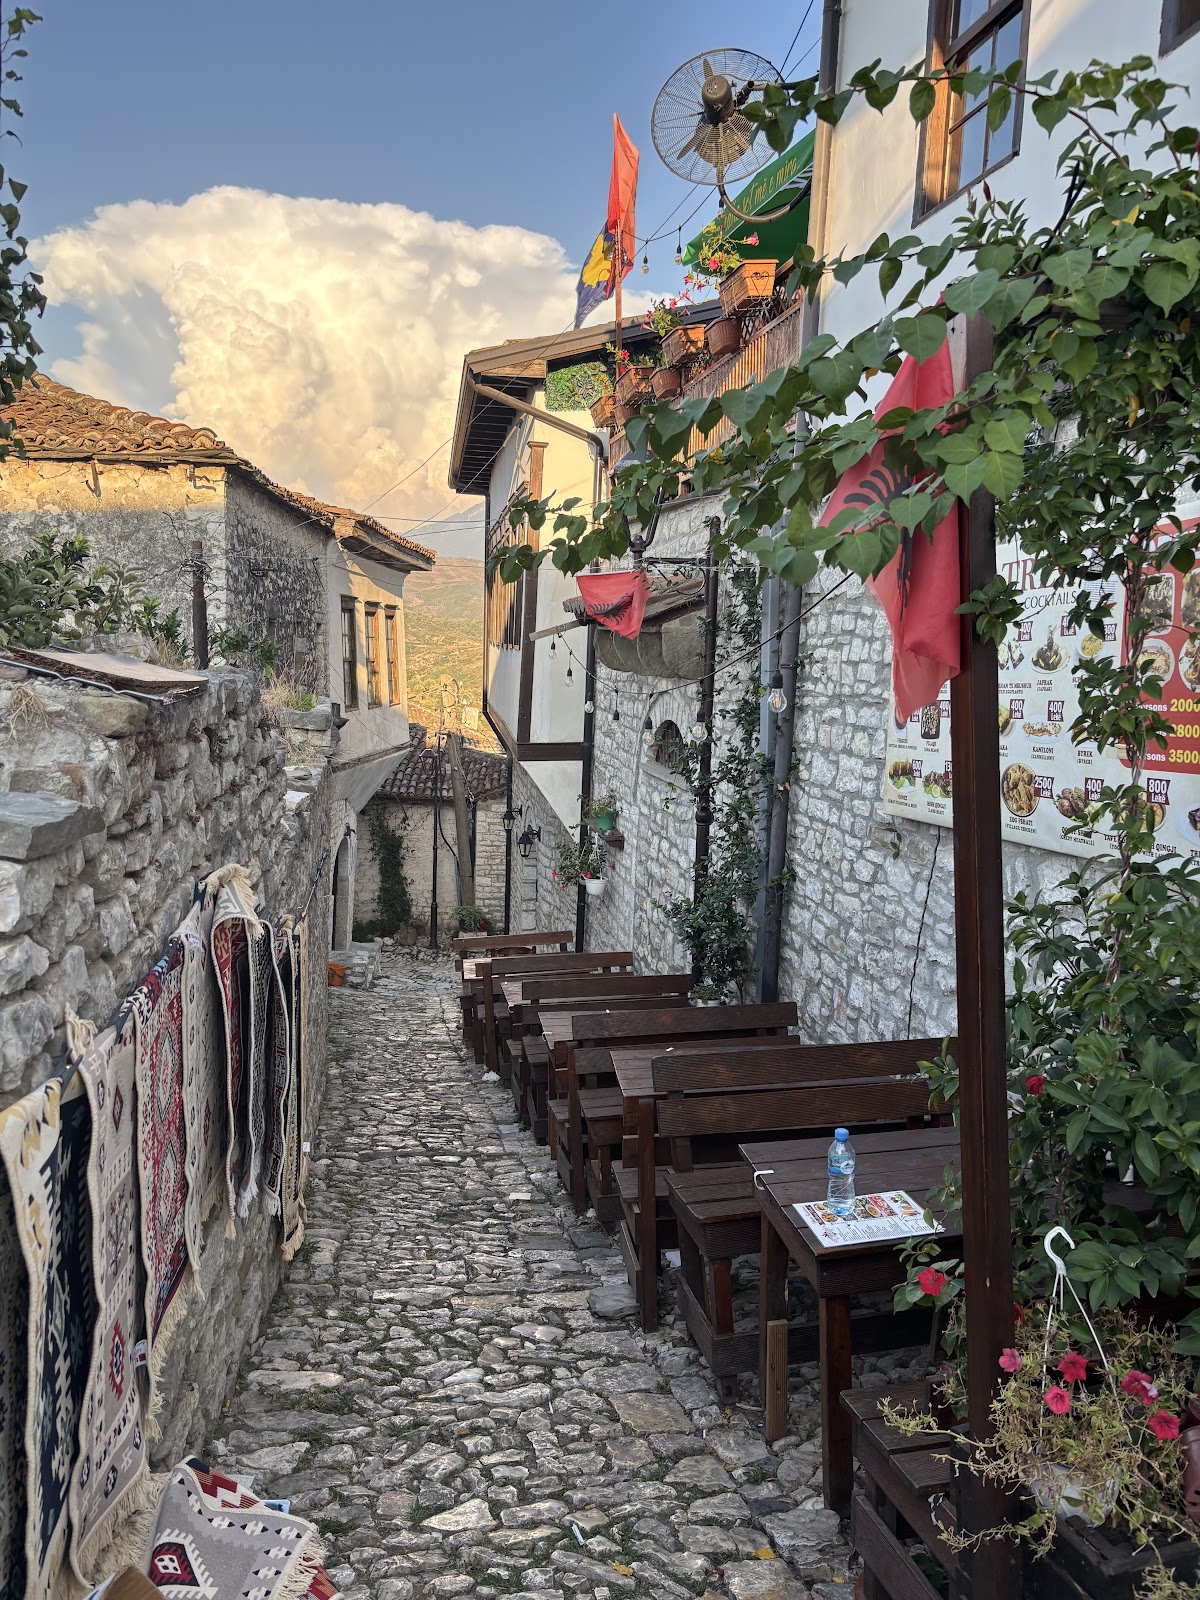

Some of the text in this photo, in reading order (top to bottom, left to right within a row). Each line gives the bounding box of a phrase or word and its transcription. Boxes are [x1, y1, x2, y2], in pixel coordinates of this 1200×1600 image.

[1024, 590, 1077, 610] COCKTAILS
[1010, 700, 1023, 711] 400
[1049, 702, 1063, 714] 400
[1168, 748, 1199, 765] 3500
[1034, 776, 1053, 790] 2500
[1086, 779, 1102, 792] 400
[1148, 779, 1168, 794] 800
[1151, 793, 1167, 803] Lekë
